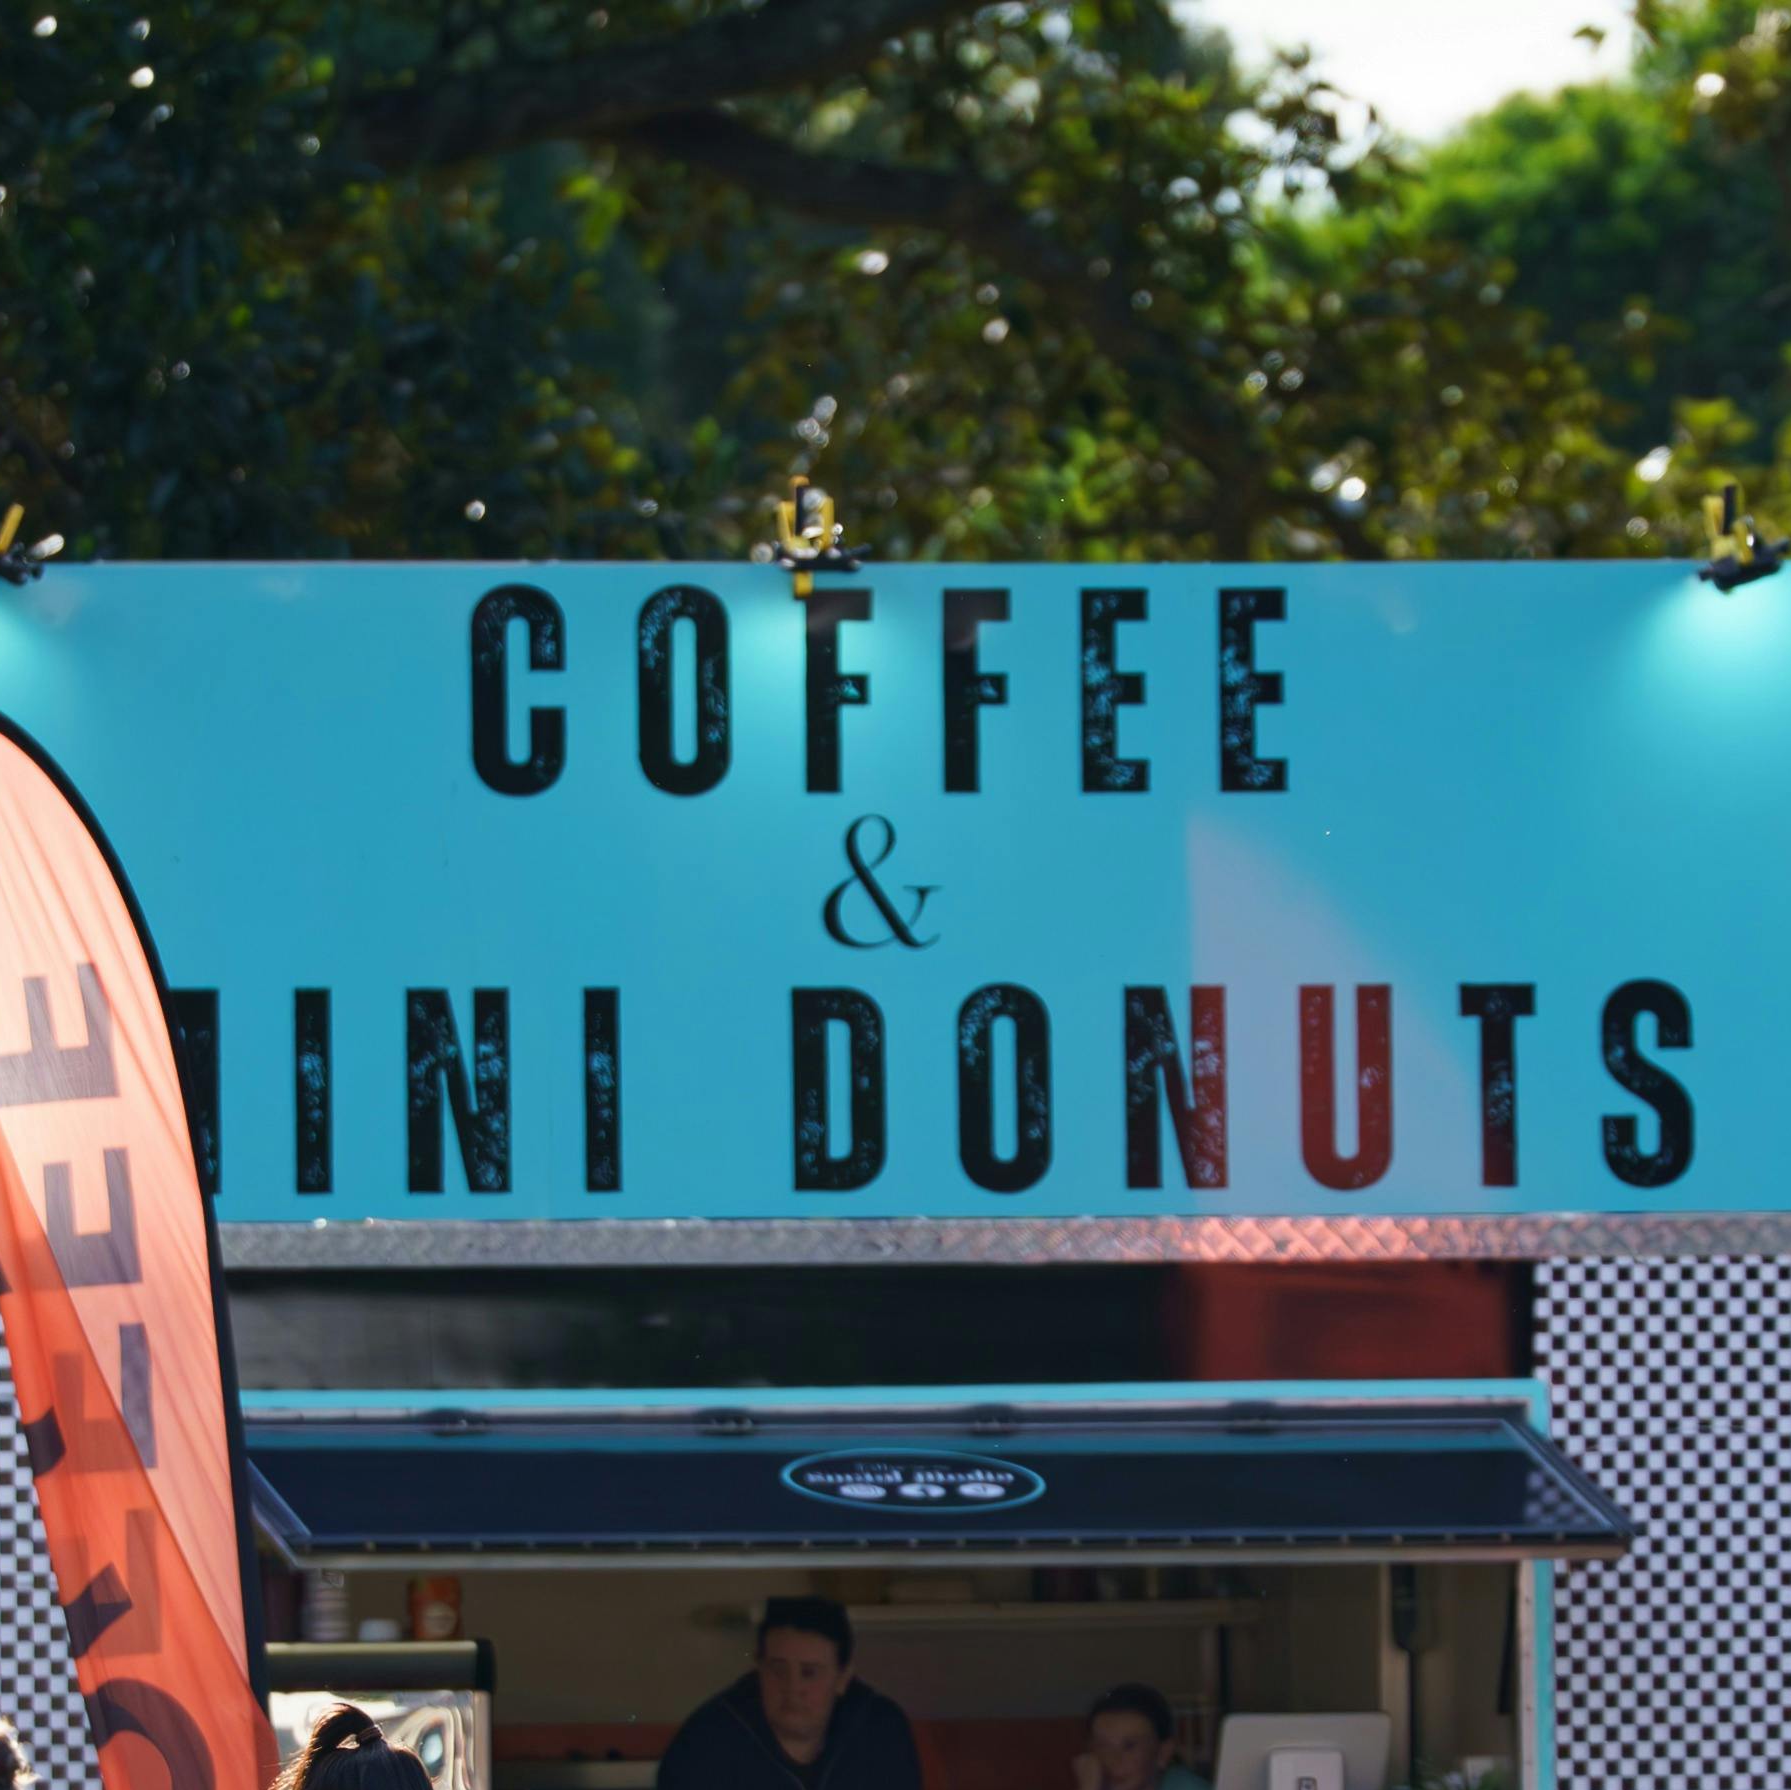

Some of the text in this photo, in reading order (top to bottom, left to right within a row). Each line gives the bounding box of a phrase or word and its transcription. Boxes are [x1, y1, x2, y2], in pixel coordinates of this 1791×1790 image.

[469, 583, 1290, 798] COFFEE
[821, 813, 942, 950] &
[167, 978, 1696, 1195] INI DONUTS
